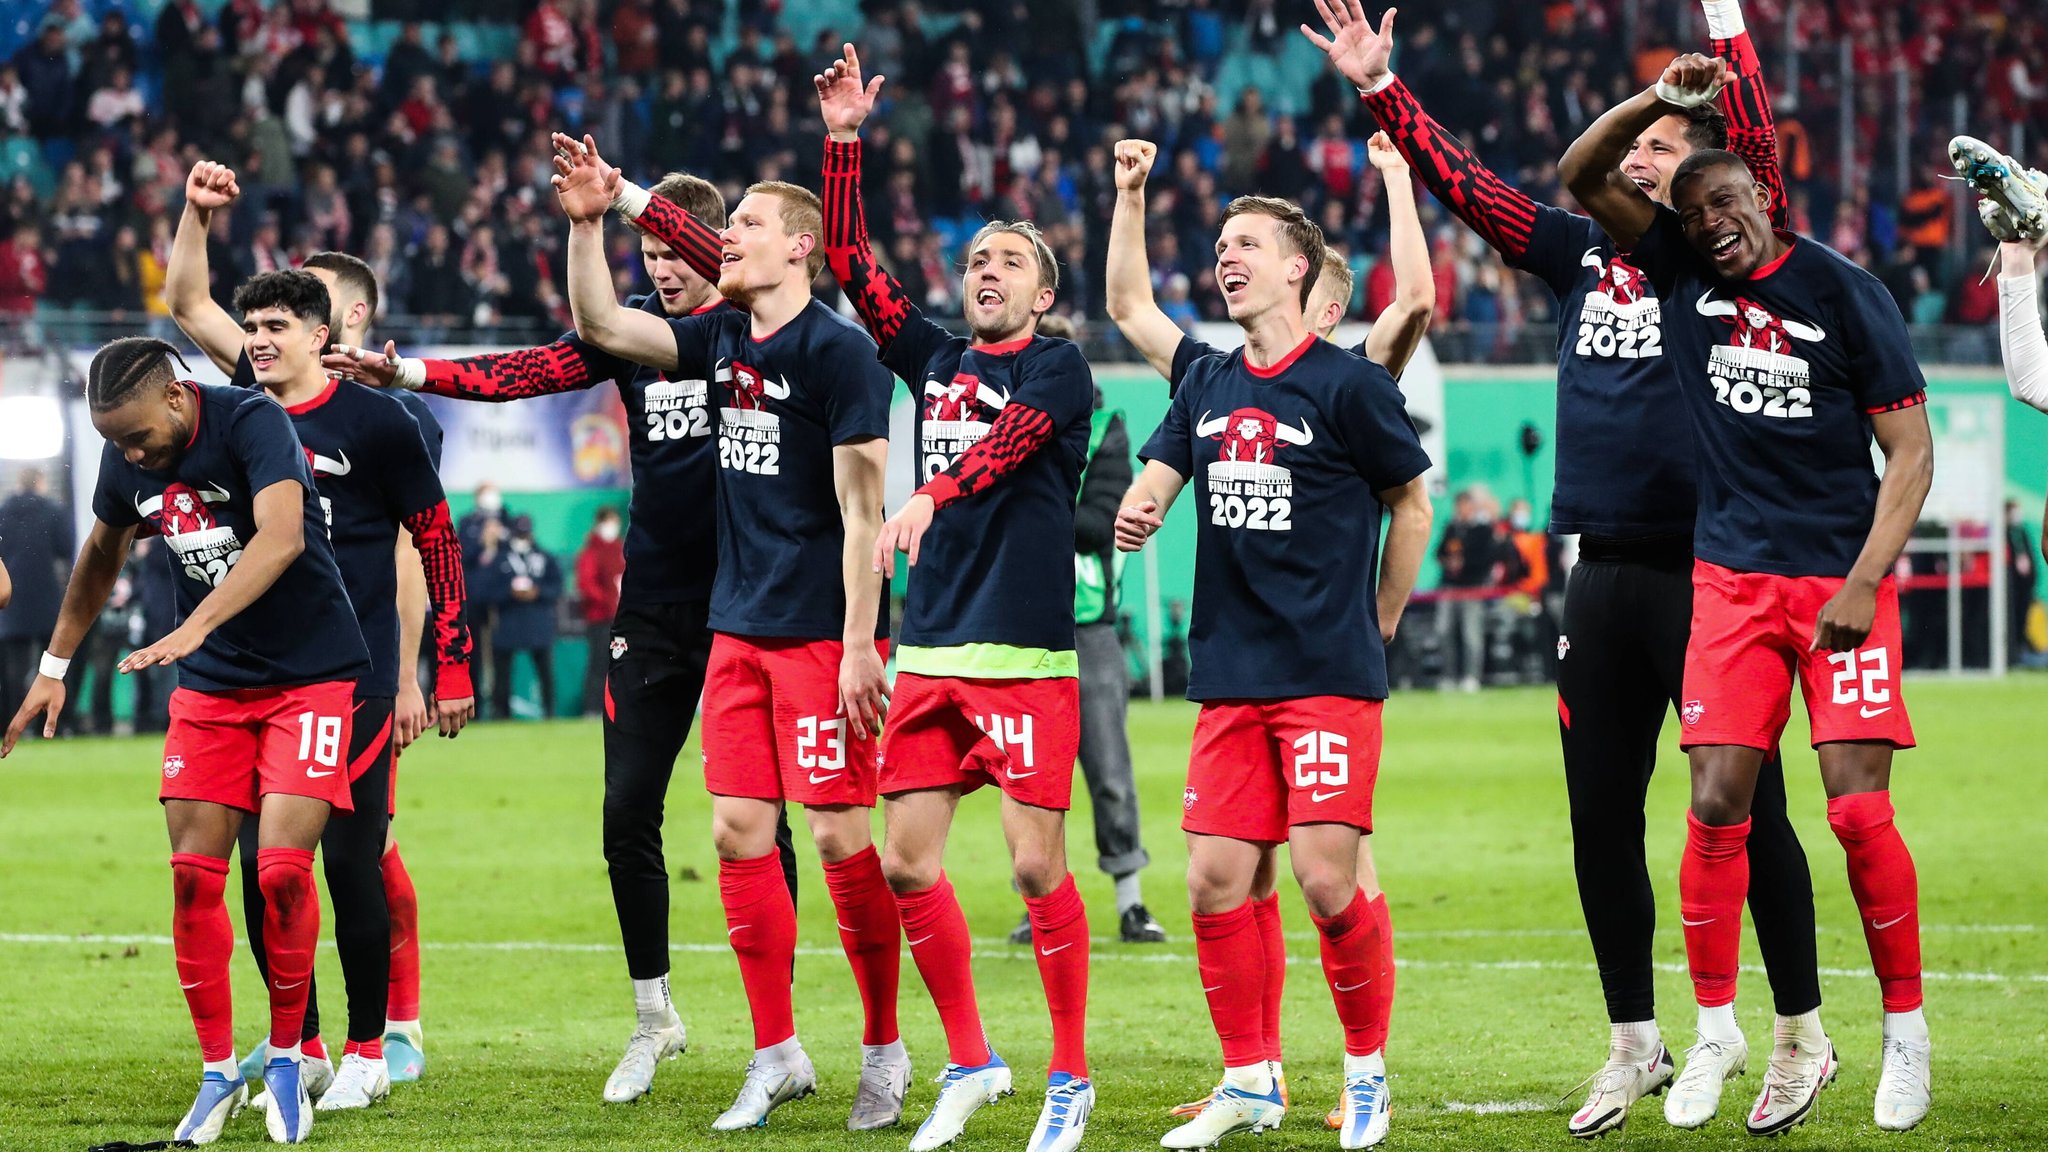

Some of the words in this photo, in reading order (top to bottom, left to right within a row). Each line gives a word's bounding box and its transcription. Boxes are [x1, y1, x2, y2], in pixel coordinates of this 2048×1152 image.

[1580, 309, 1615, 326] FINALE
[1616, 311, 1661, 331] BERLIN
[1576, 323, 1663, 359] 2022
[1707, 361, 1755, 382] FINALE
[1758, 371, 1810, 388] BERLIN
[645, 398, 684, 414] FINALE
[685, 393, 709, 408] BER
[1710, 376, 1813, 418] 2022
[647, 407, 711, 442] 202
[719, 424, 745, 441] FIALE
[744, 428, 780, 443] BERLIN
[718, 436, 780, 475] 2022
[1208, 480, 1242, 495] FINALE
[1244, 482, 1292, 498] BERLIN
[1210, 493, 1292, 531] 2022
[196, 540, 242, 563] BERLIN
[1827, 646, 1890, 705] 22
[298, 710, 342, 767] 18
[796, 715, 847, 770] 23
[975, 713, 1034, 768] 44
[1293, 730, 1349, 787] 25
